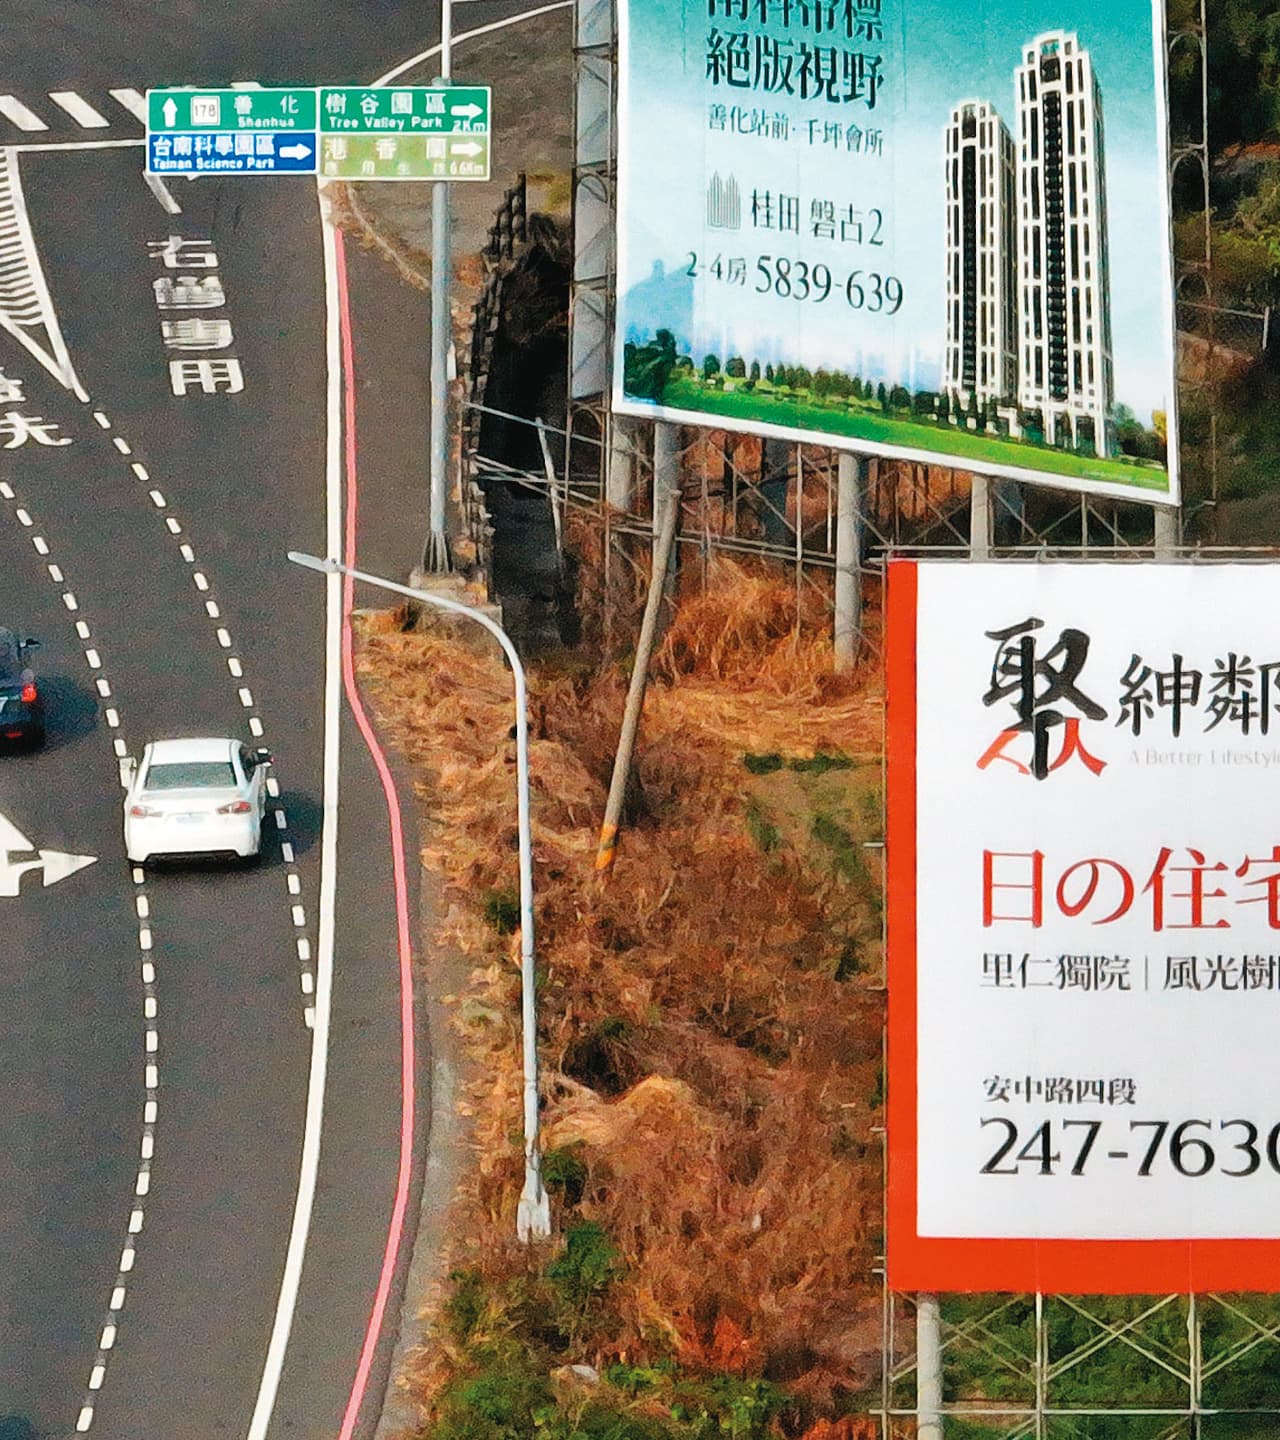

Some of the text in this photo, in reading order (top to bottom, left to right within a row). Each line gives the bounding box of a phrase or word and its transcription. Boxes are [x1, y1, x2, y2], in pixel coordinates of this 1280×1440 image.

[704, 27, 885, 111] 絕版視野
[193, 103, 218, 118] 178
[329, 116, 443, 131] Tree Valley Park
[153, 134, 276, 157] 台南科學園區
[153, 157, 276, 171] Tainan Science Park
[748, 187, 802, 237] 桂田
[685, 251, 905, 317] 2-4房 5839-639
[146, 235, 246, 396] 右轉專用
[1145, 748, 1203, 765] Better
[980, 1073, 1138, 1107] 安中路四段
